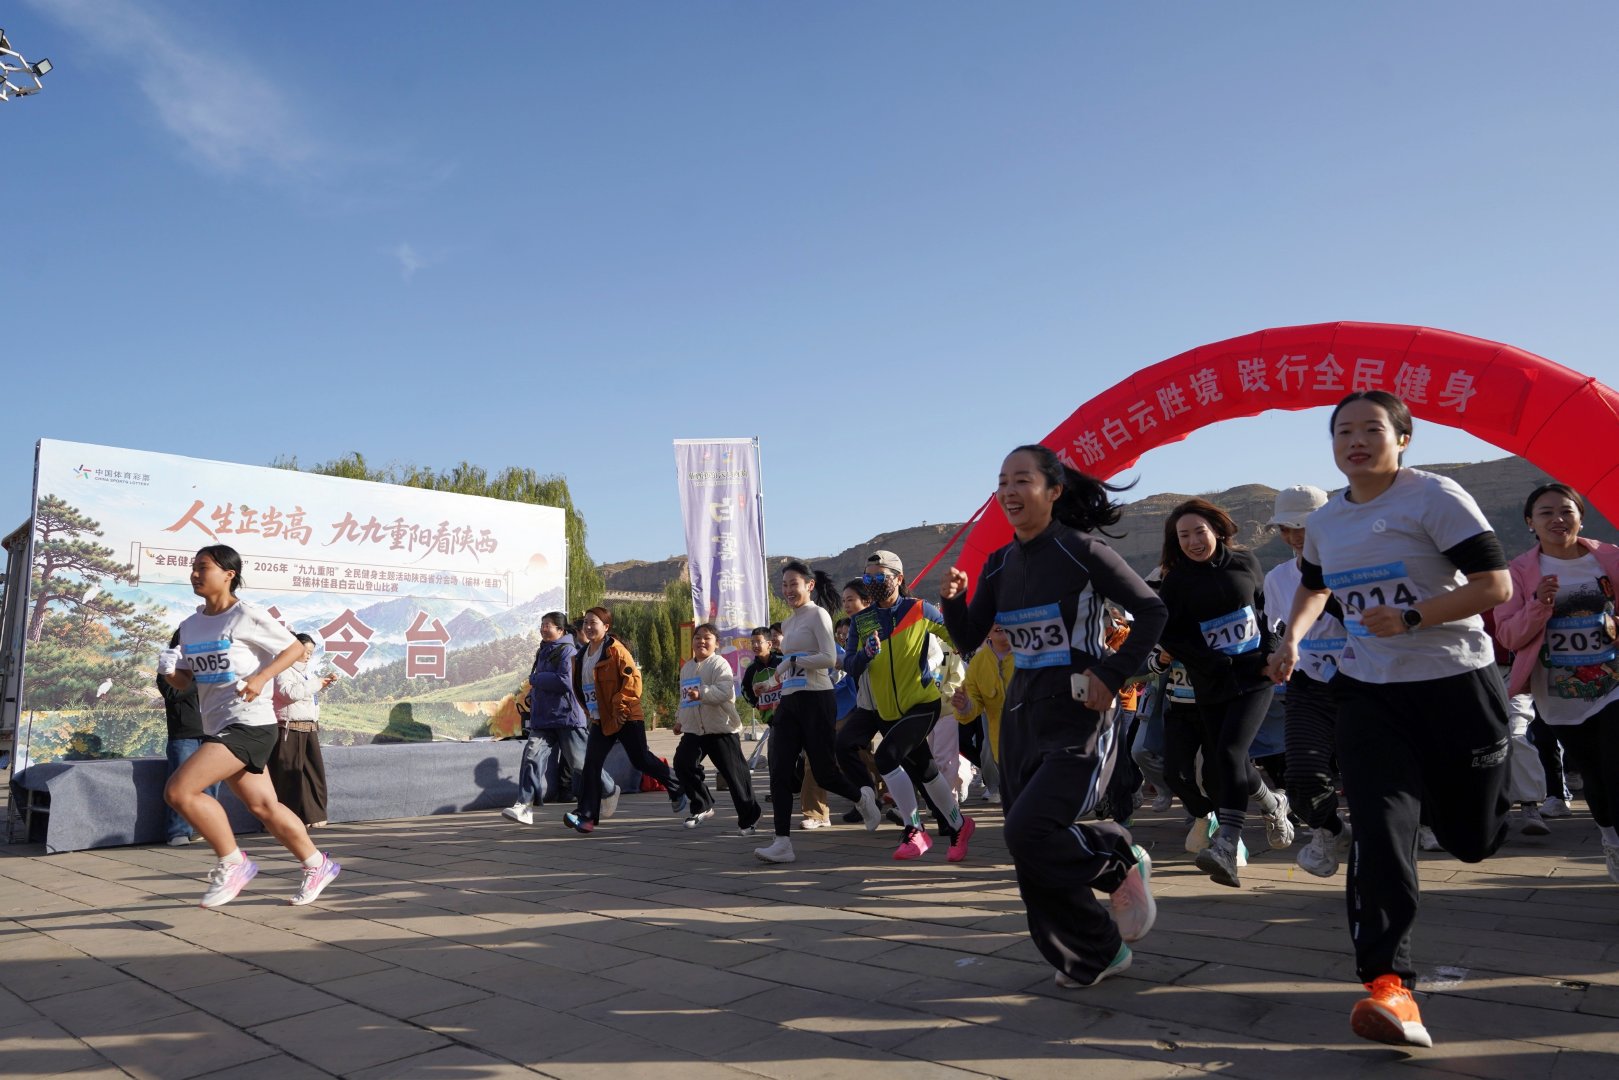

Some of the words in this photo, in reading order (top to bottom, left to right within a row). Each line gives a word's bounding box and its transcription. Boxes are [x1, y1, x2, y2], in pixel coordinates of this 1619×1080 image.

[1237, 352, 1477, 413] 践行全民健身
[95, 468, 150, 482] 中国体育彩票
[160, 500, 313, 546] 人生正当高
[321, 511, 498, 564] 九九重阳看陕西
[292, 575, 399, 593] 暨榆林佳县白云山登山比赛
[1004, 624, 1064, 650] 2053
[1207, 619, 1254, 649] 2107
[187, 652, 231, 673] 2065
